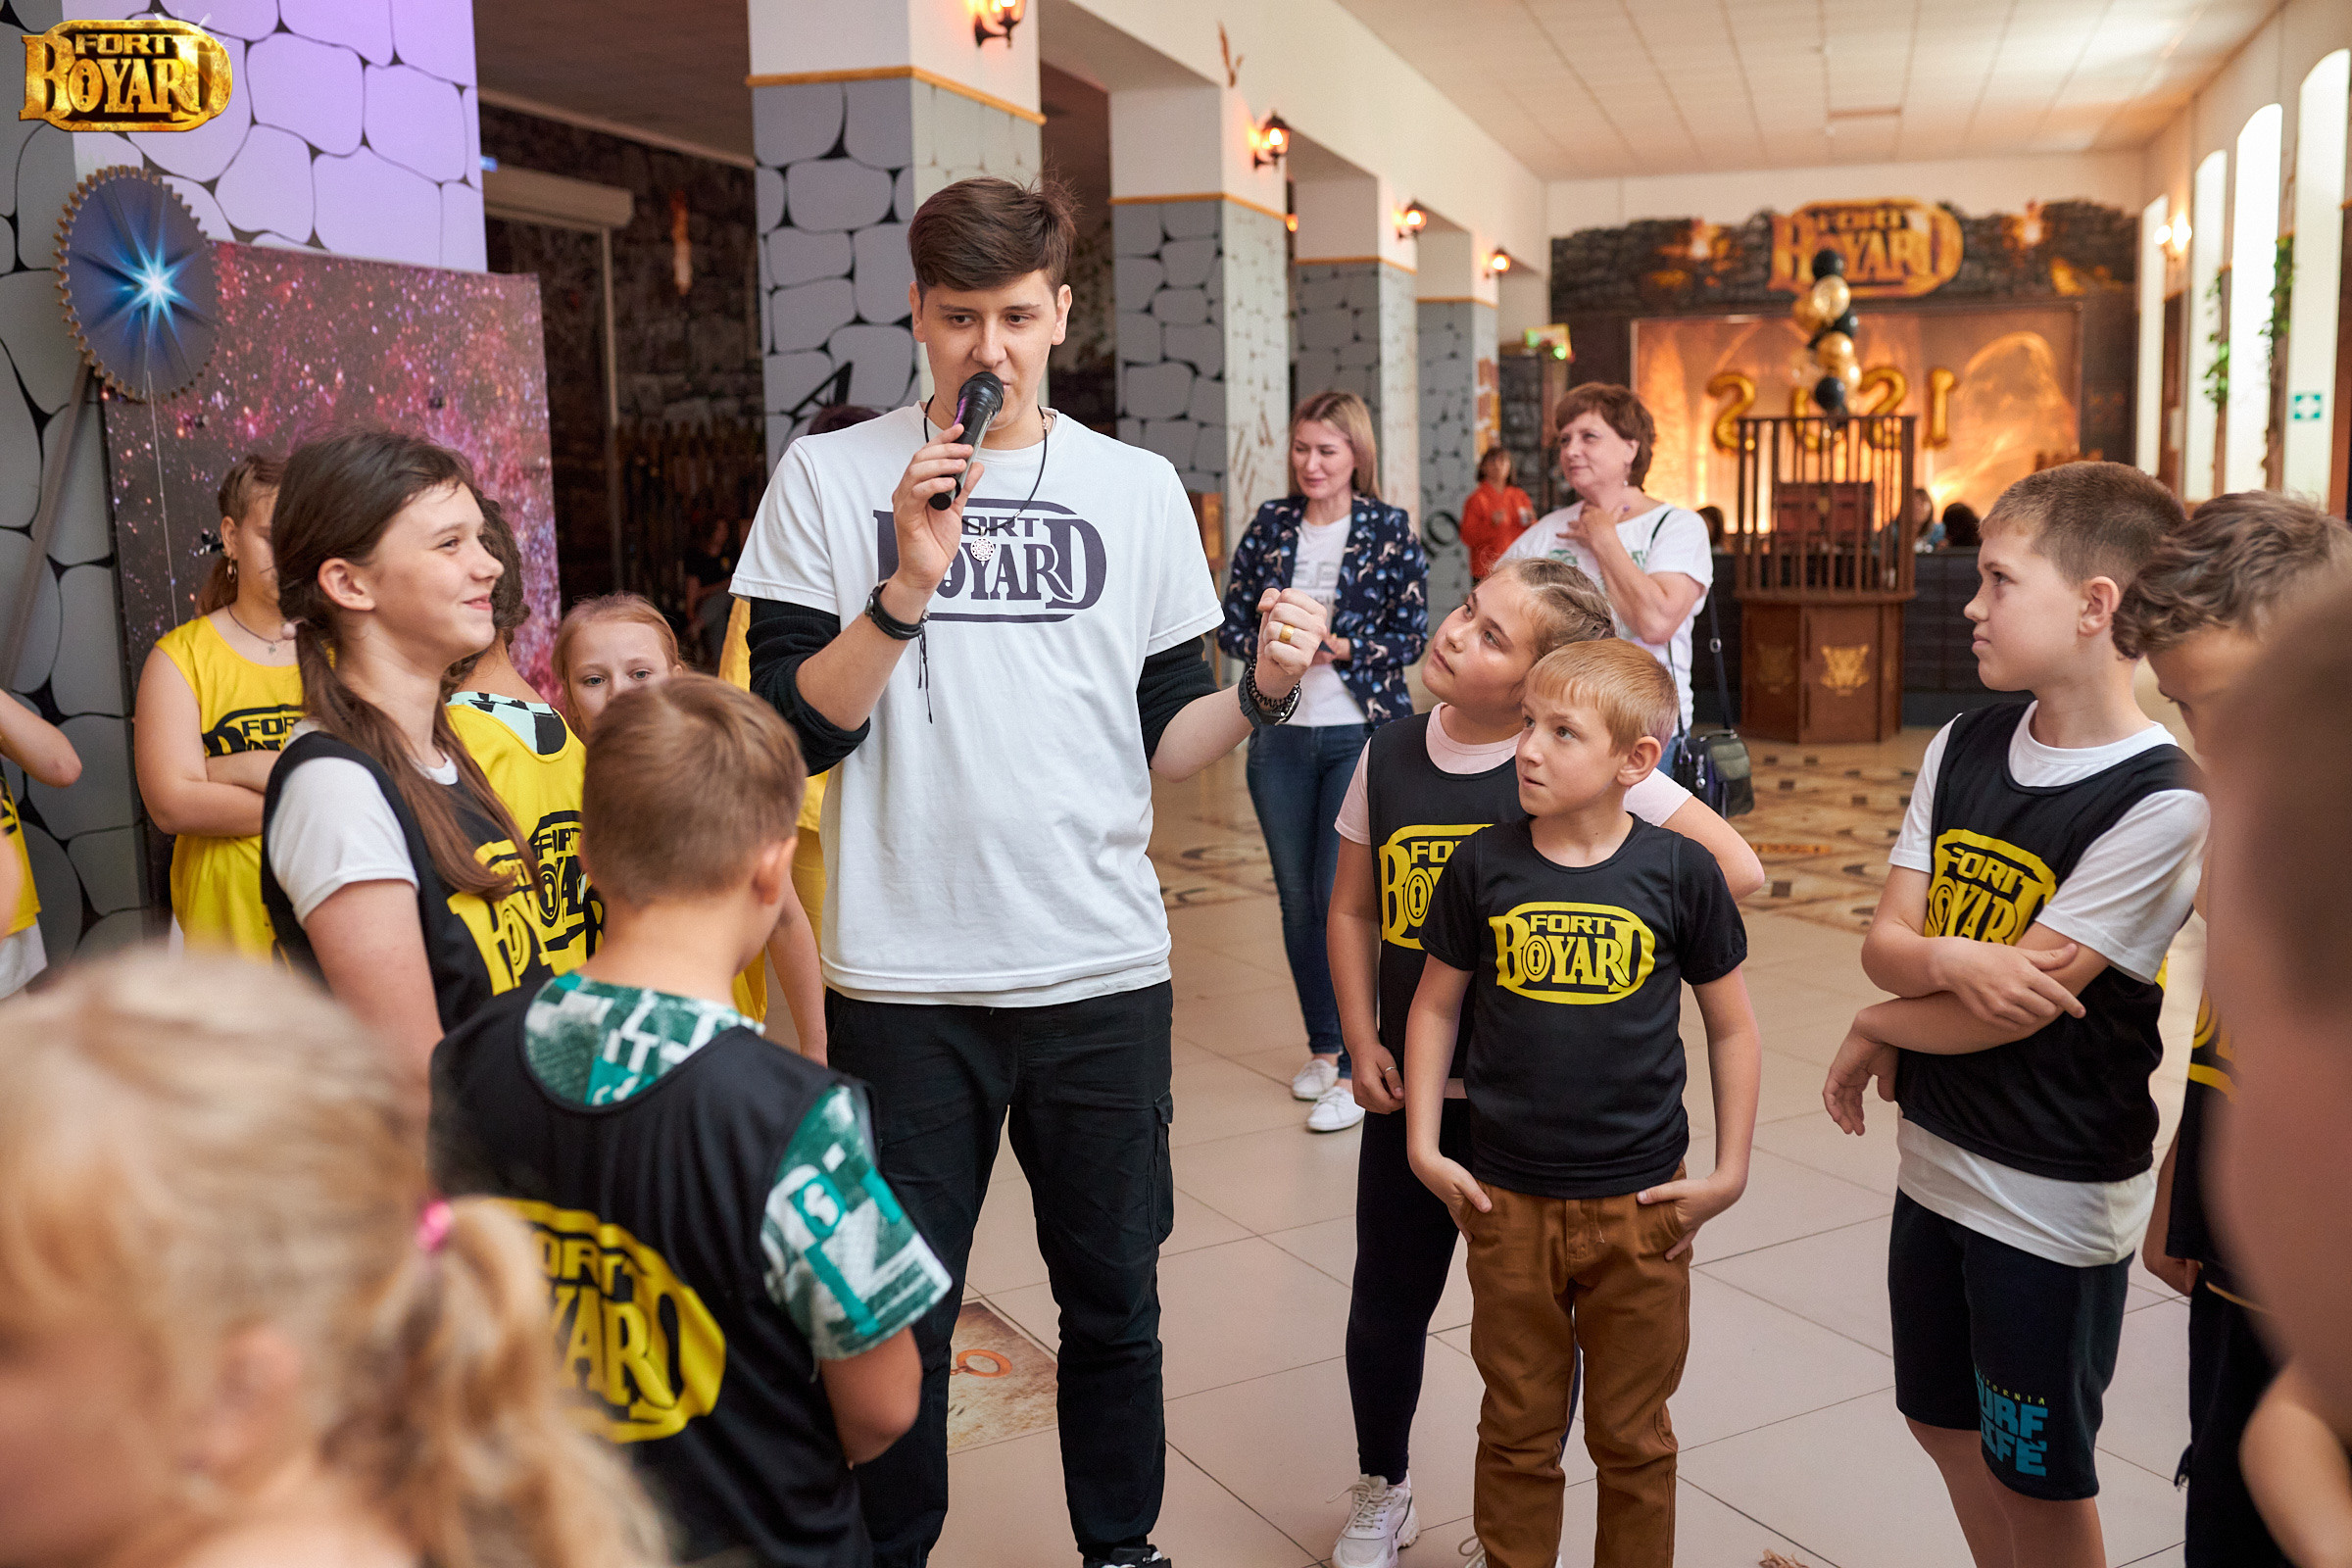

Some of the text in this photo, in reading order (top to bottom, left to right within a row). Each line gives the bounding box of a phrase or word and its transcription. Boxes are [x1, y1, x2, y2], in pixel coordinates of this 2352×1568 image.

[961, 514, 1040, 538] ORT
[873, 510, 1106, 610] OYARD
[1411, 840, 1461, 863] FO
[1530, 914, 1611, 935] FORT
[1489, 915, 1655, 993] BOYARD
[534, 1231, 624, 1297] ORT
